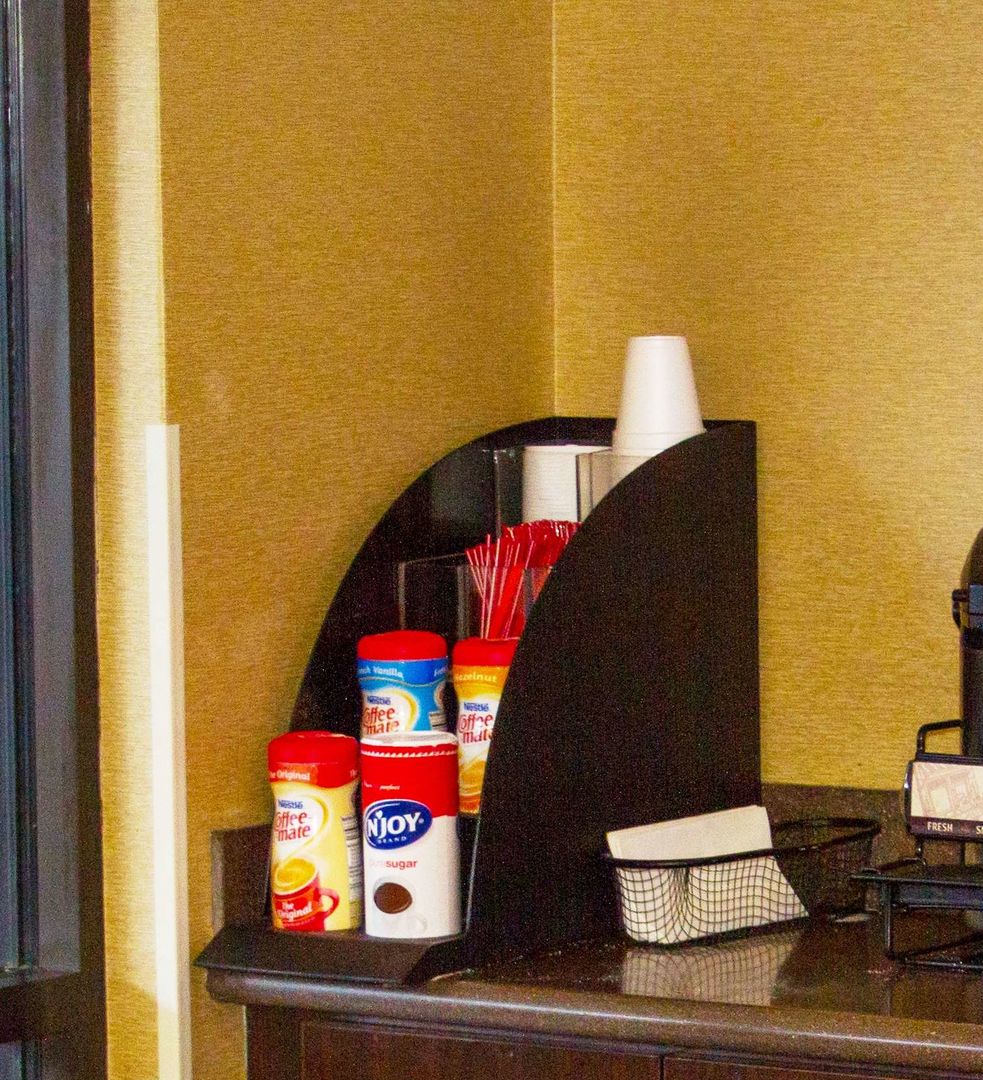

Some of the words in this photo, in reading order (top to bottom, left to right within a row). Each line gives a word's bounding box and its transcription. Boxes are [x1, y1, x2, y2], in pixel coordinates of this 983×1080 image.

[373, 666, 404, 680] Vanilla
[276, 769, 310, 781] Original
[927, 821, 953, 833] FRESH
[278, 825, 311, 842] mate
[385, 860, 417, 870] sugar
